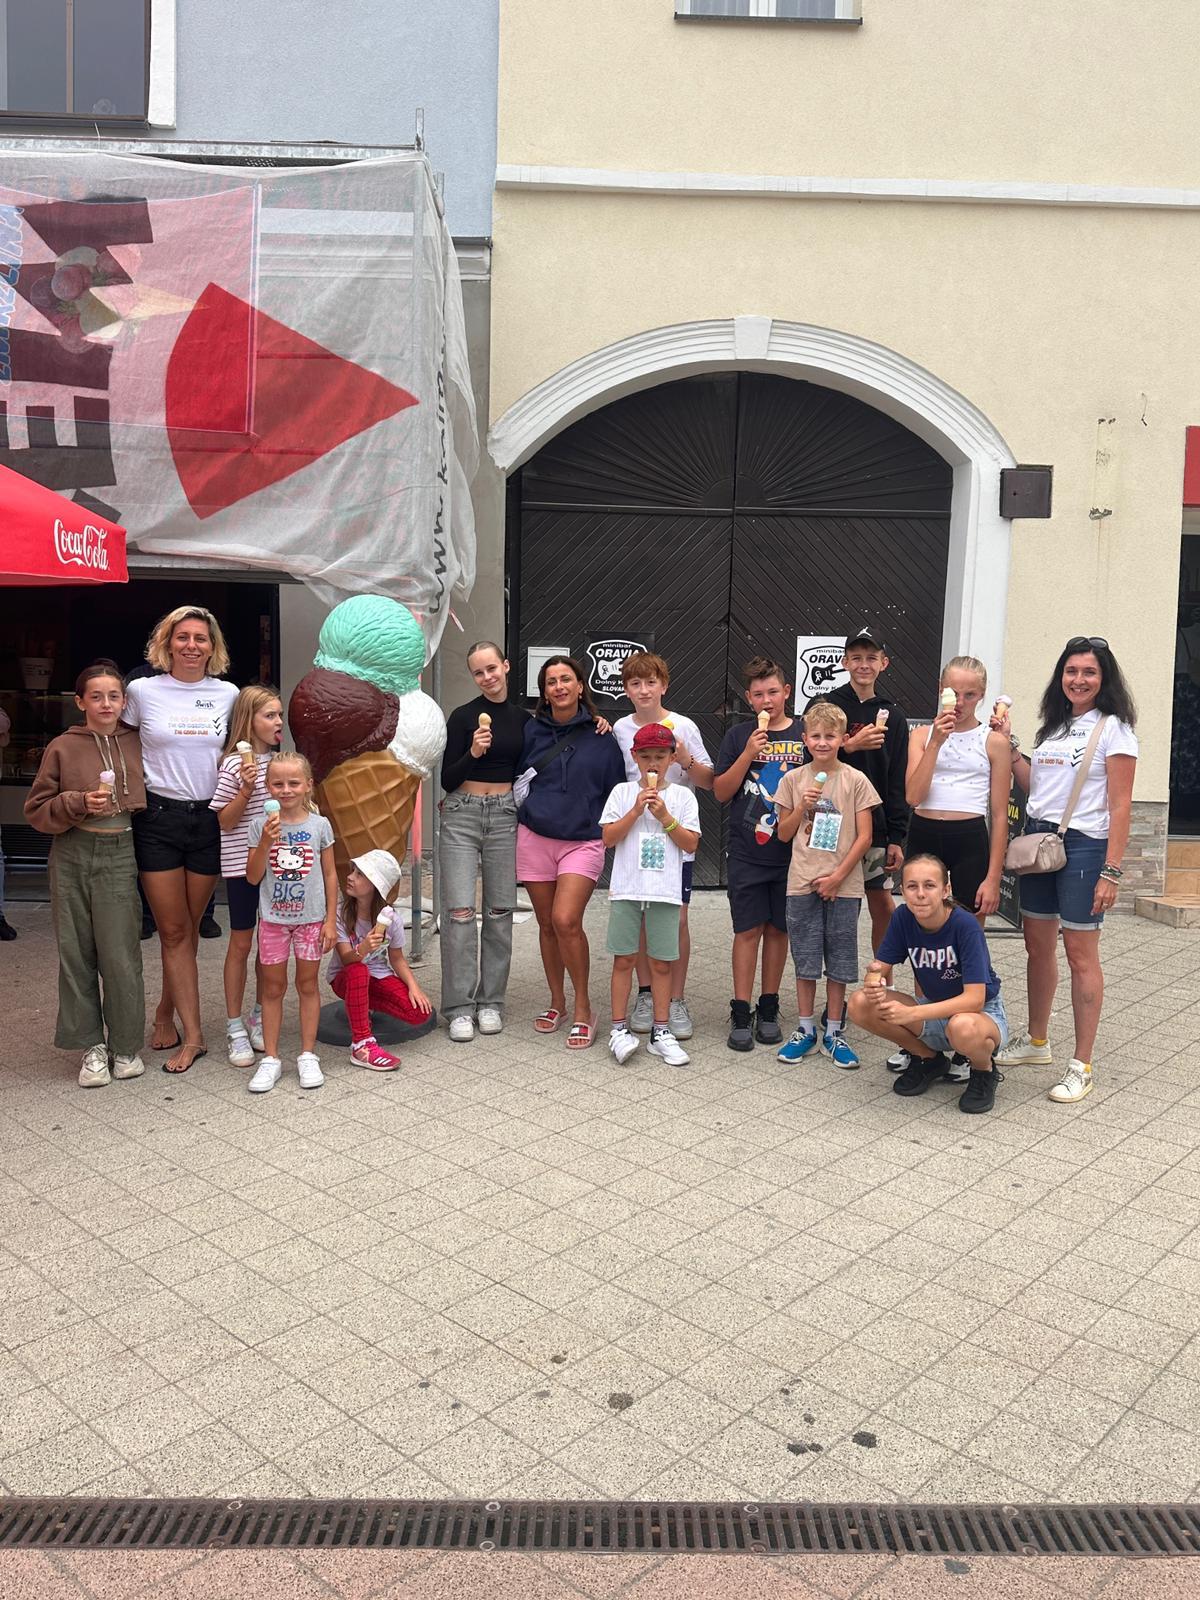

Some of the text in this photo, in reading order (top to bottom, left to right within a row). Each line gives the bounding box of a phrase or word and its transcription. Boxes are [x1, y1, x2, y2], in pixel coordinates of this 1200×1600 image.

[809, 654, 843, 664] ORAV
[761, 742, 803, 755] ONIC
[1007, 804, 1019, 820] VIA
[272, 882, 305, 899] BIG
[907, 945, 959, 970] KAPPA
